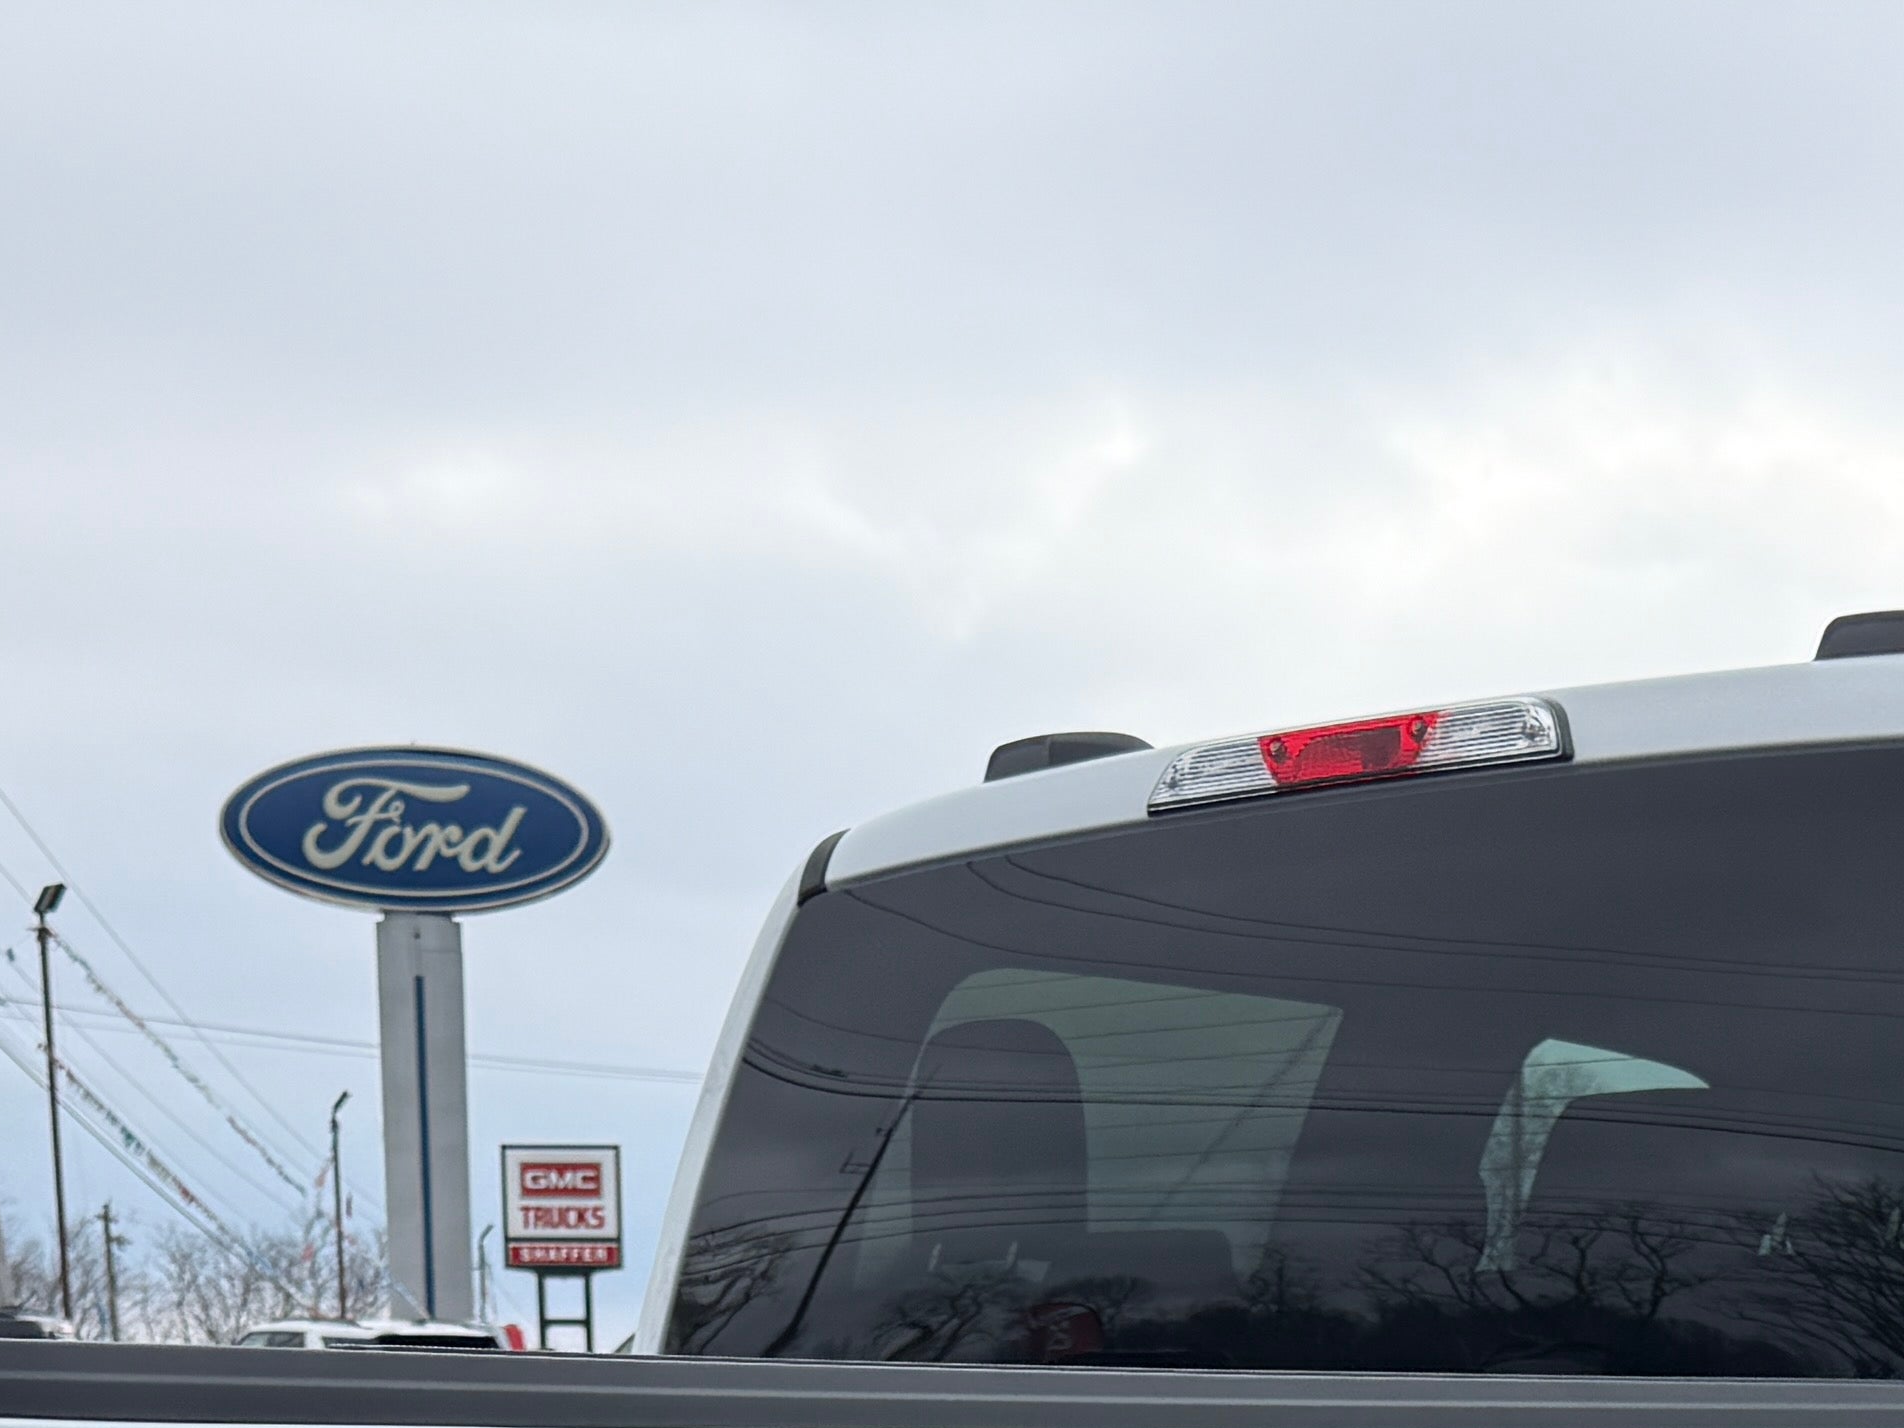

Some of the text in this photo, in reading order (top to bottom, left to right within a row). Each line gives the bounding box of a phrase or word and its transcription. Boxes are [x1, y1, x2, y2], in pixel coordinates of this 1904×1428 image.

[302, 777, 528, 874] Ford
[524, 1168, 598, 1190] GMC
[520, 1205, 605, 1230] TRUCKS
[520, 1248, 609, 1262] SHAFFER
